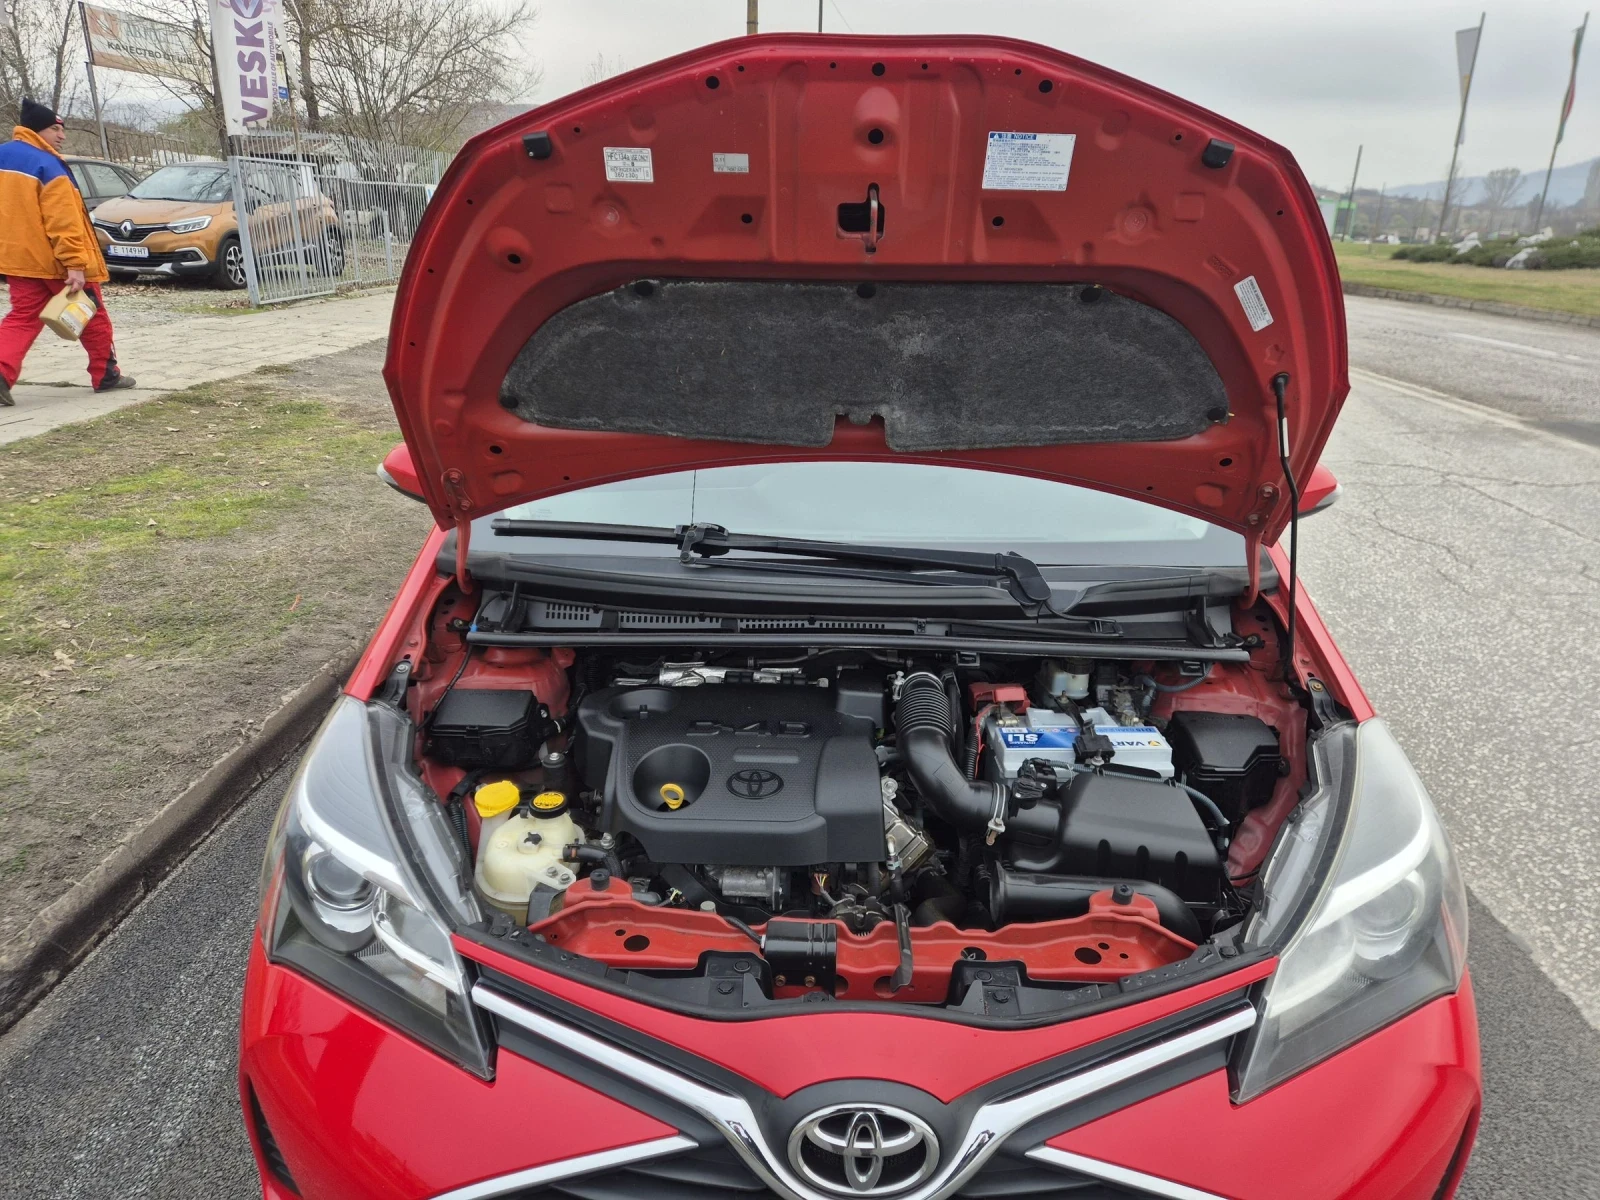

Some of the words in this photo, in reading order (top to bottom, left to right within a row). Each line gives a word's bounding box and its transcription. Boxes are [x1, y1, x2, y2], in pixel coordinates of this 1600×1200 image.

[266, 21, 276, 62] AUTOMOBILE
[107, 41, 162, 60] КАЧЕСТВО
[269, 62, 277, 71] OF
[270, 71, 278, 87] SALE
[1007, 733, 1039, 742] SLI
